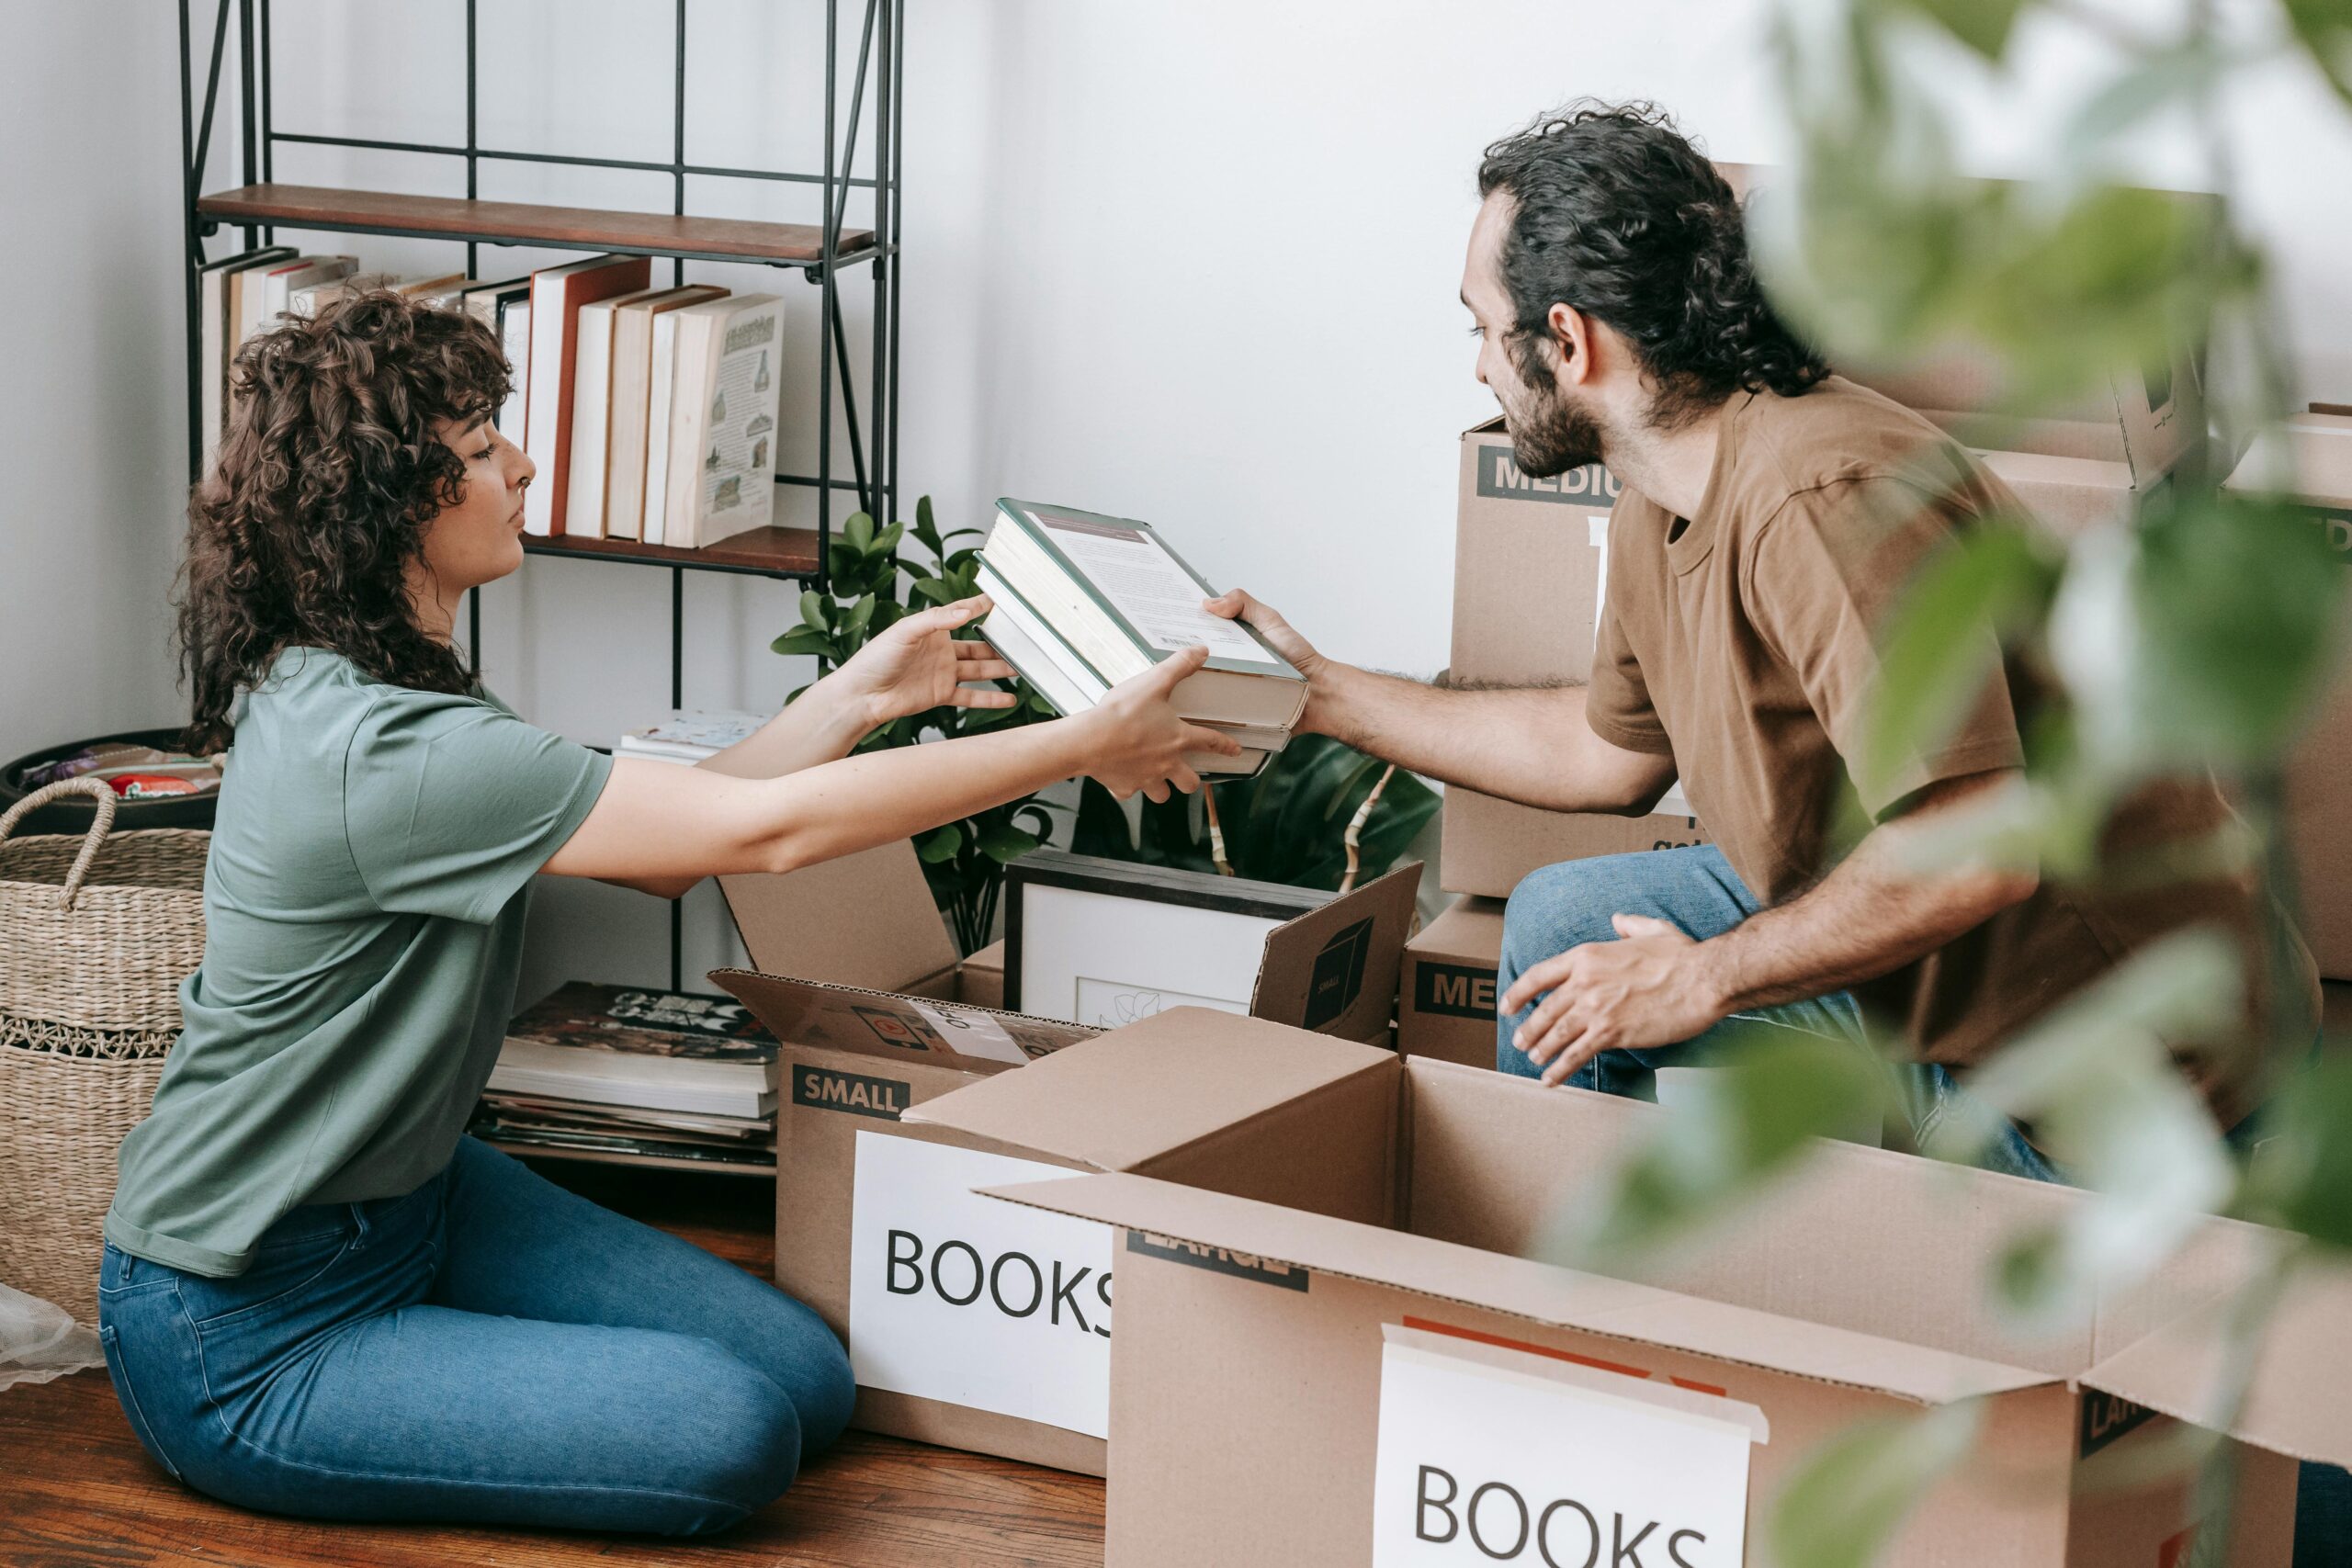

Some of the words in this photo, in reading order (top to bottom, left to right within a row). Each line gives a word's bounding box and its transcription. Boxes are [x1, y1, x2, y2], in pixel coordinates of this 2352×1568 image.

[1433, 973, 1496, 1010] ME
[805, 1073, 899, 1113] SMALL
[1416, 1464, 1706, 1568] BOOKS
